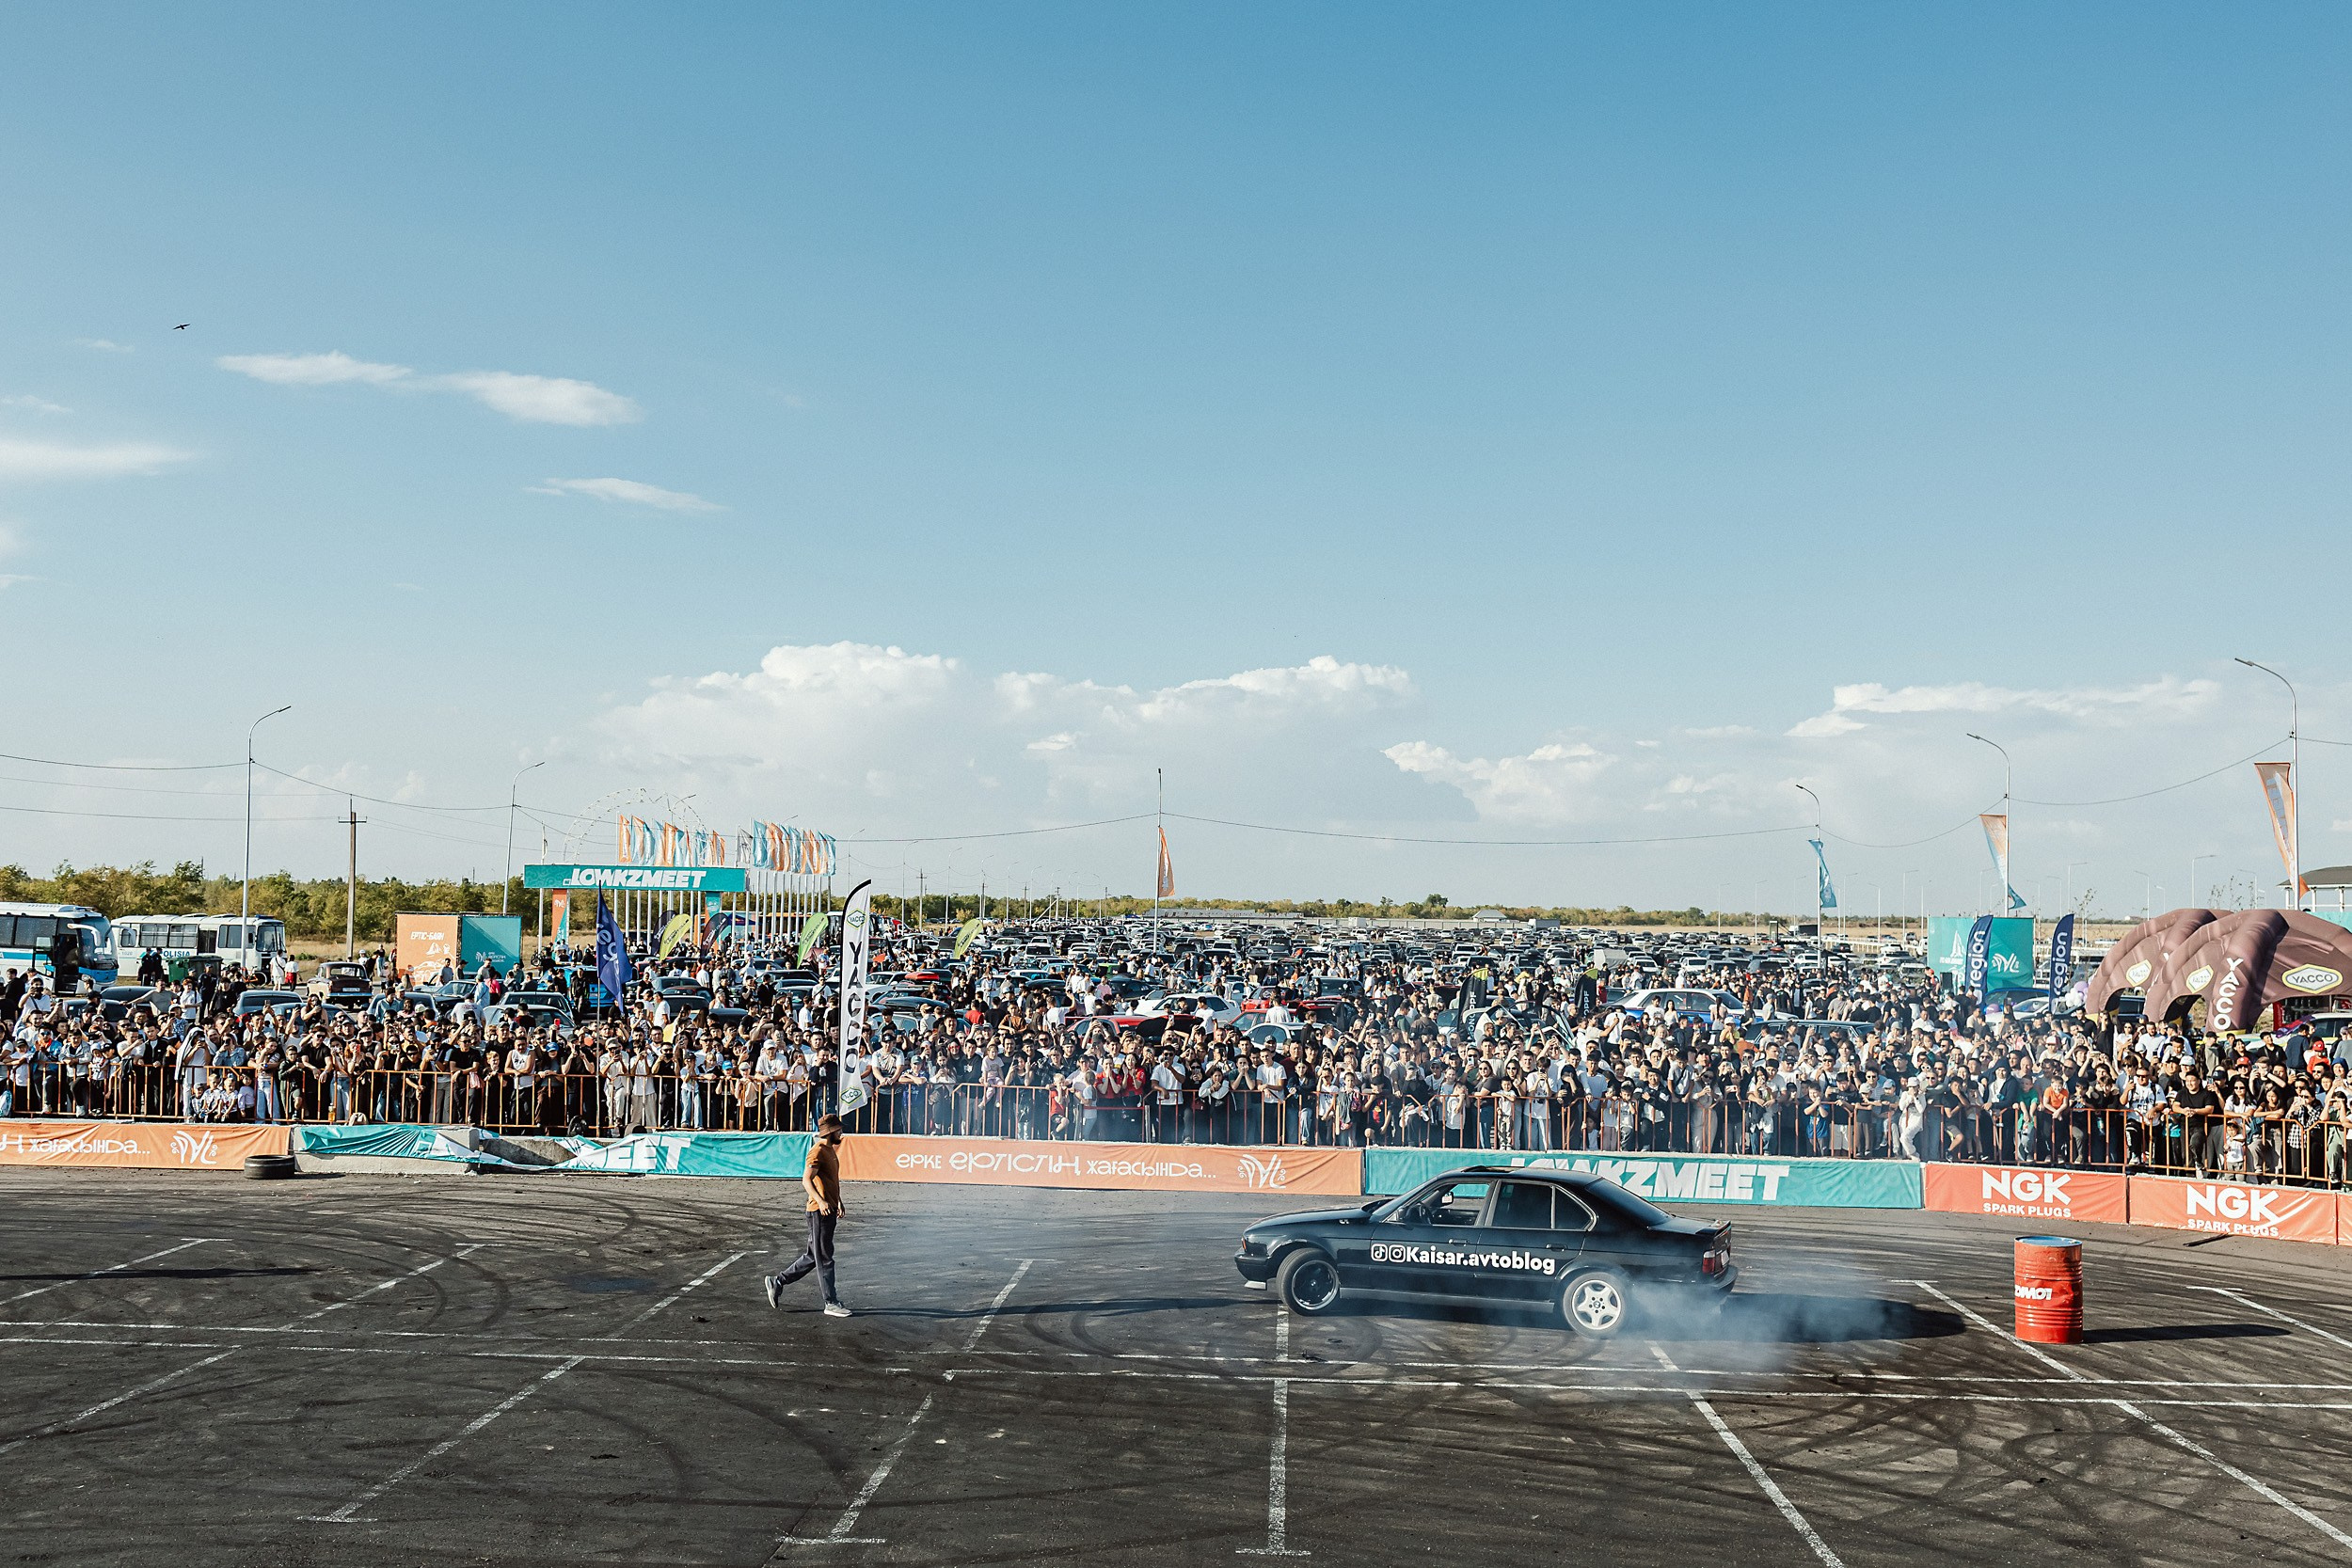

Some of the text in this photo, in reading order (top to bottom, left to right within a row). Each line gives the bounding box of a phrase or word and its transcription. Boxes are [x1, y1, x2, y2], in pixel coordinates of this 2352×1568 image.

[570, 868, 707, 888] LOWKZMEET
[162, 950, 191, 958] OLISIA
[1968, 930, 1988, 988] region
[2053, 932, 2068, 996] region
[2214, 957, 2244, 1030] YACCO
[2292, 974, 2333, 984] YACCO
[844, 941, 864, 1074] YACCO
[1982, 1169, 2072, 1206] NGK
[2186, 1183, 2280, 1222] NGK
[1983, 1202, 2072, 1218] SPARK PLUGS
[2187, 1219, 2279, 1237] SPARK PLUGS
[1406, 1245, 1556, 1275] Kaisar.avtoblog
